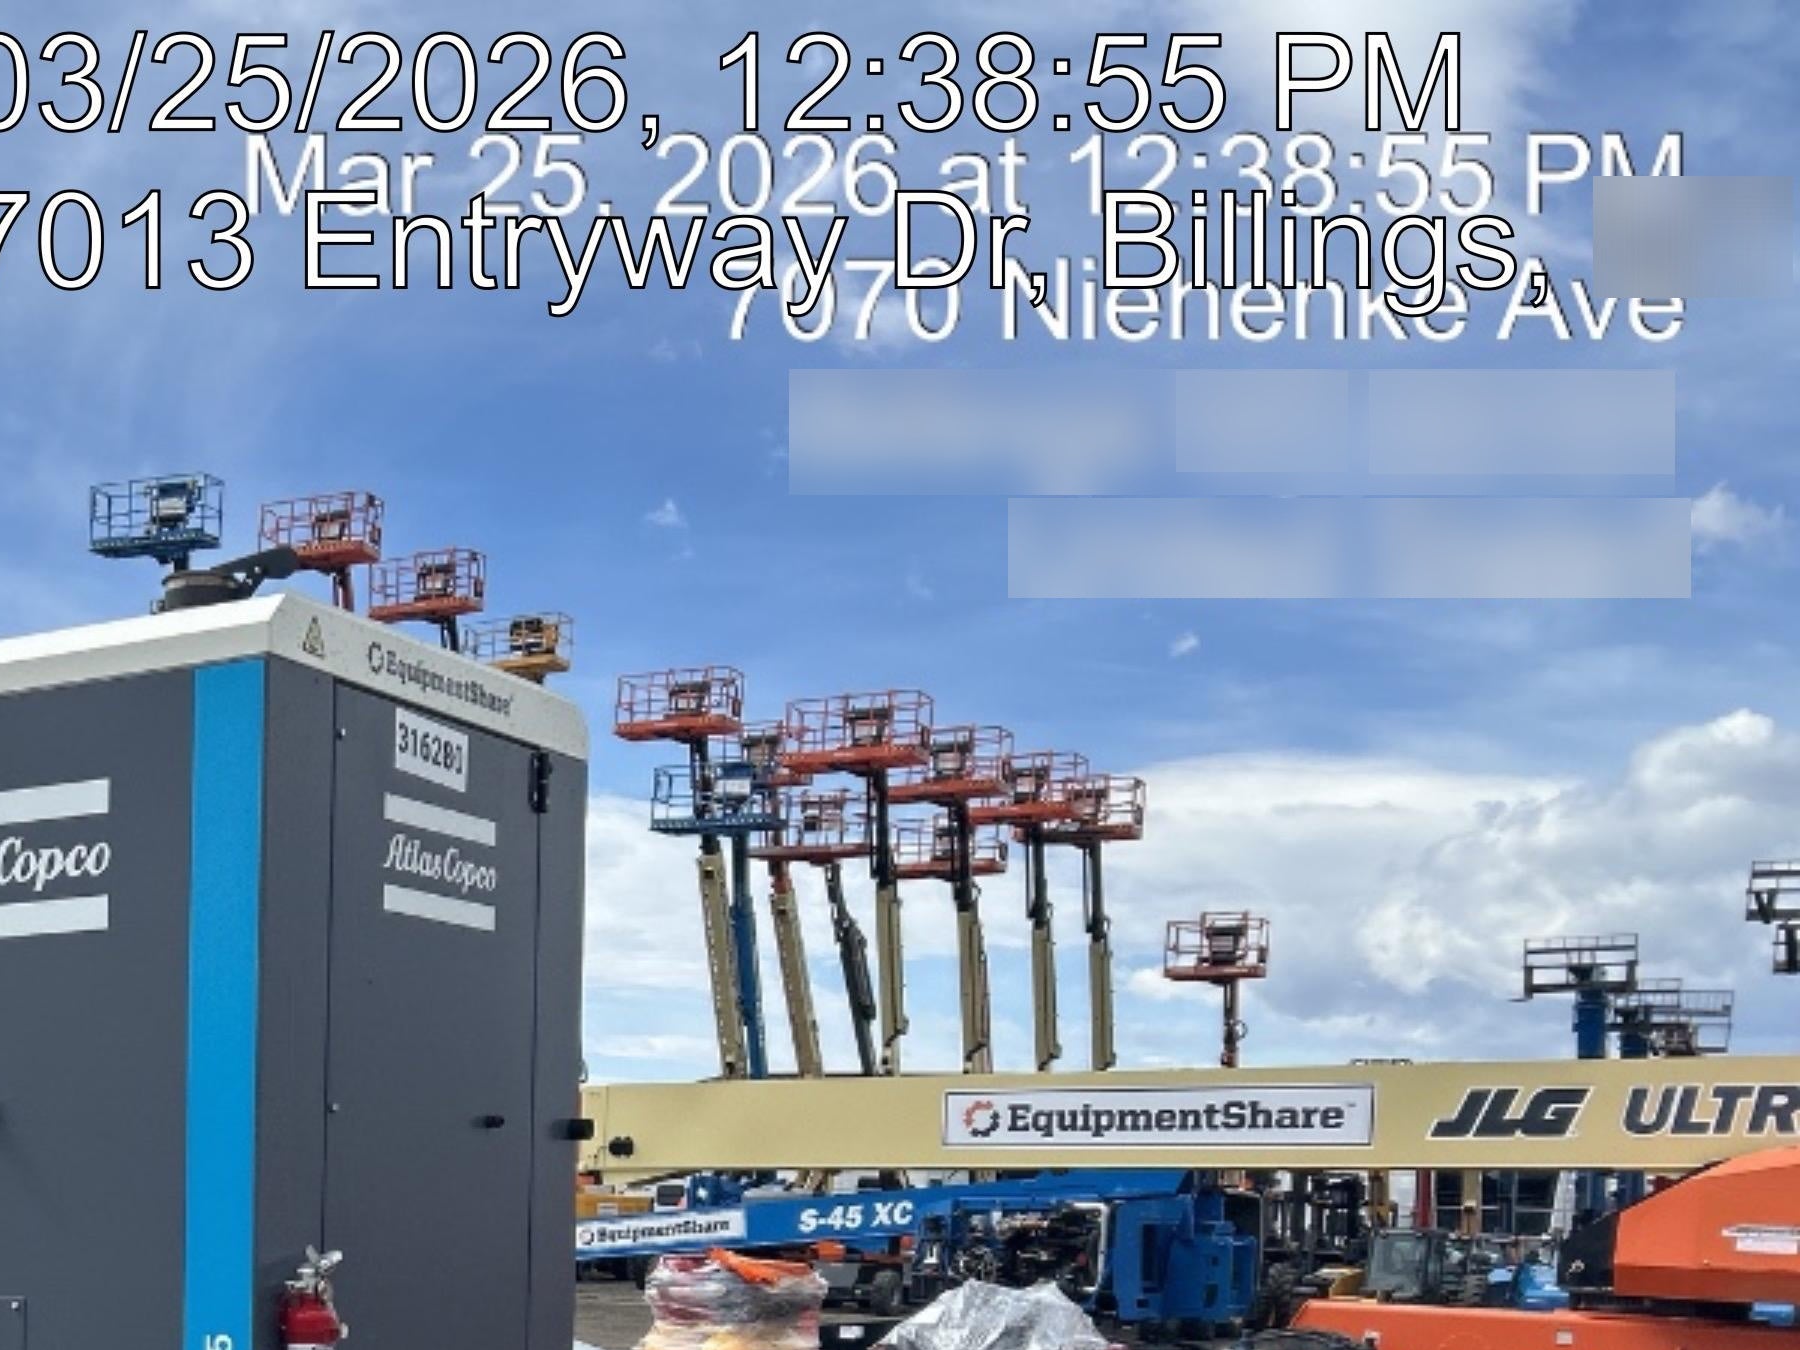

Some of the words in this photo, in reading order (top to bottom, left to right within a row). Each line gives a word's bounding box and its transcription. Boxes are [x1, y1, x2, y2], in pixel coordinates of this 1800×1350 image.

[386, 649, 512, 717] EquipmentShare
[1006, 1100, 1346, 1138] EquipmentShare
[1427, 1086, 1593, 1140] JLG
[798, 1204, 865, 1233] S-45
[871, 1200, 915, 1227] XC
